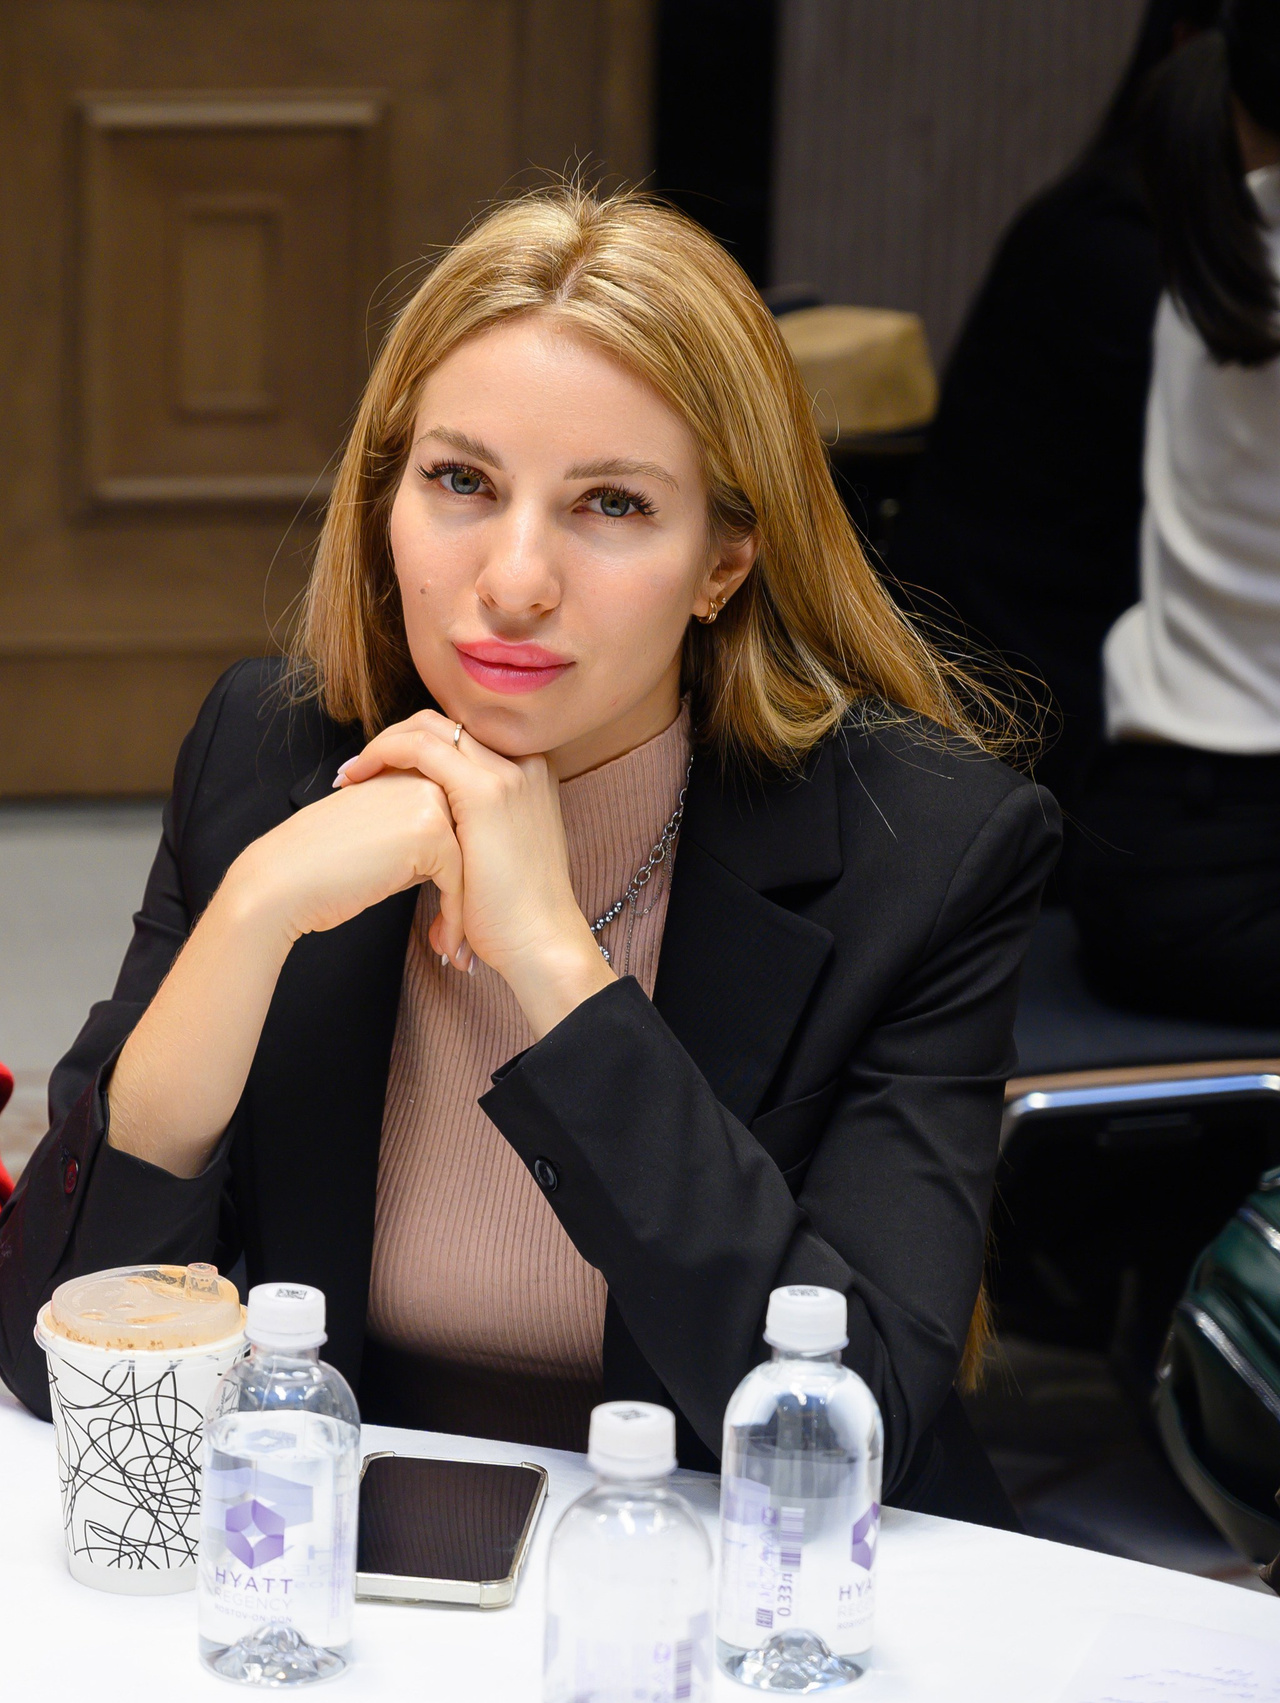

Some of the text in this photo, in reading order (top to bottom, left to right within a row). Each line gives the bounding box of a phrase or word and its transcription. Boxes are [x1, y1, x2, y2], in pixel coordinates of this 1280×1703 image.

[215, 1566, 294, 1595] HYATT
[838, 1577, 872, 1602] HYA
[214, 1586, 294, 1612] REGENCY
